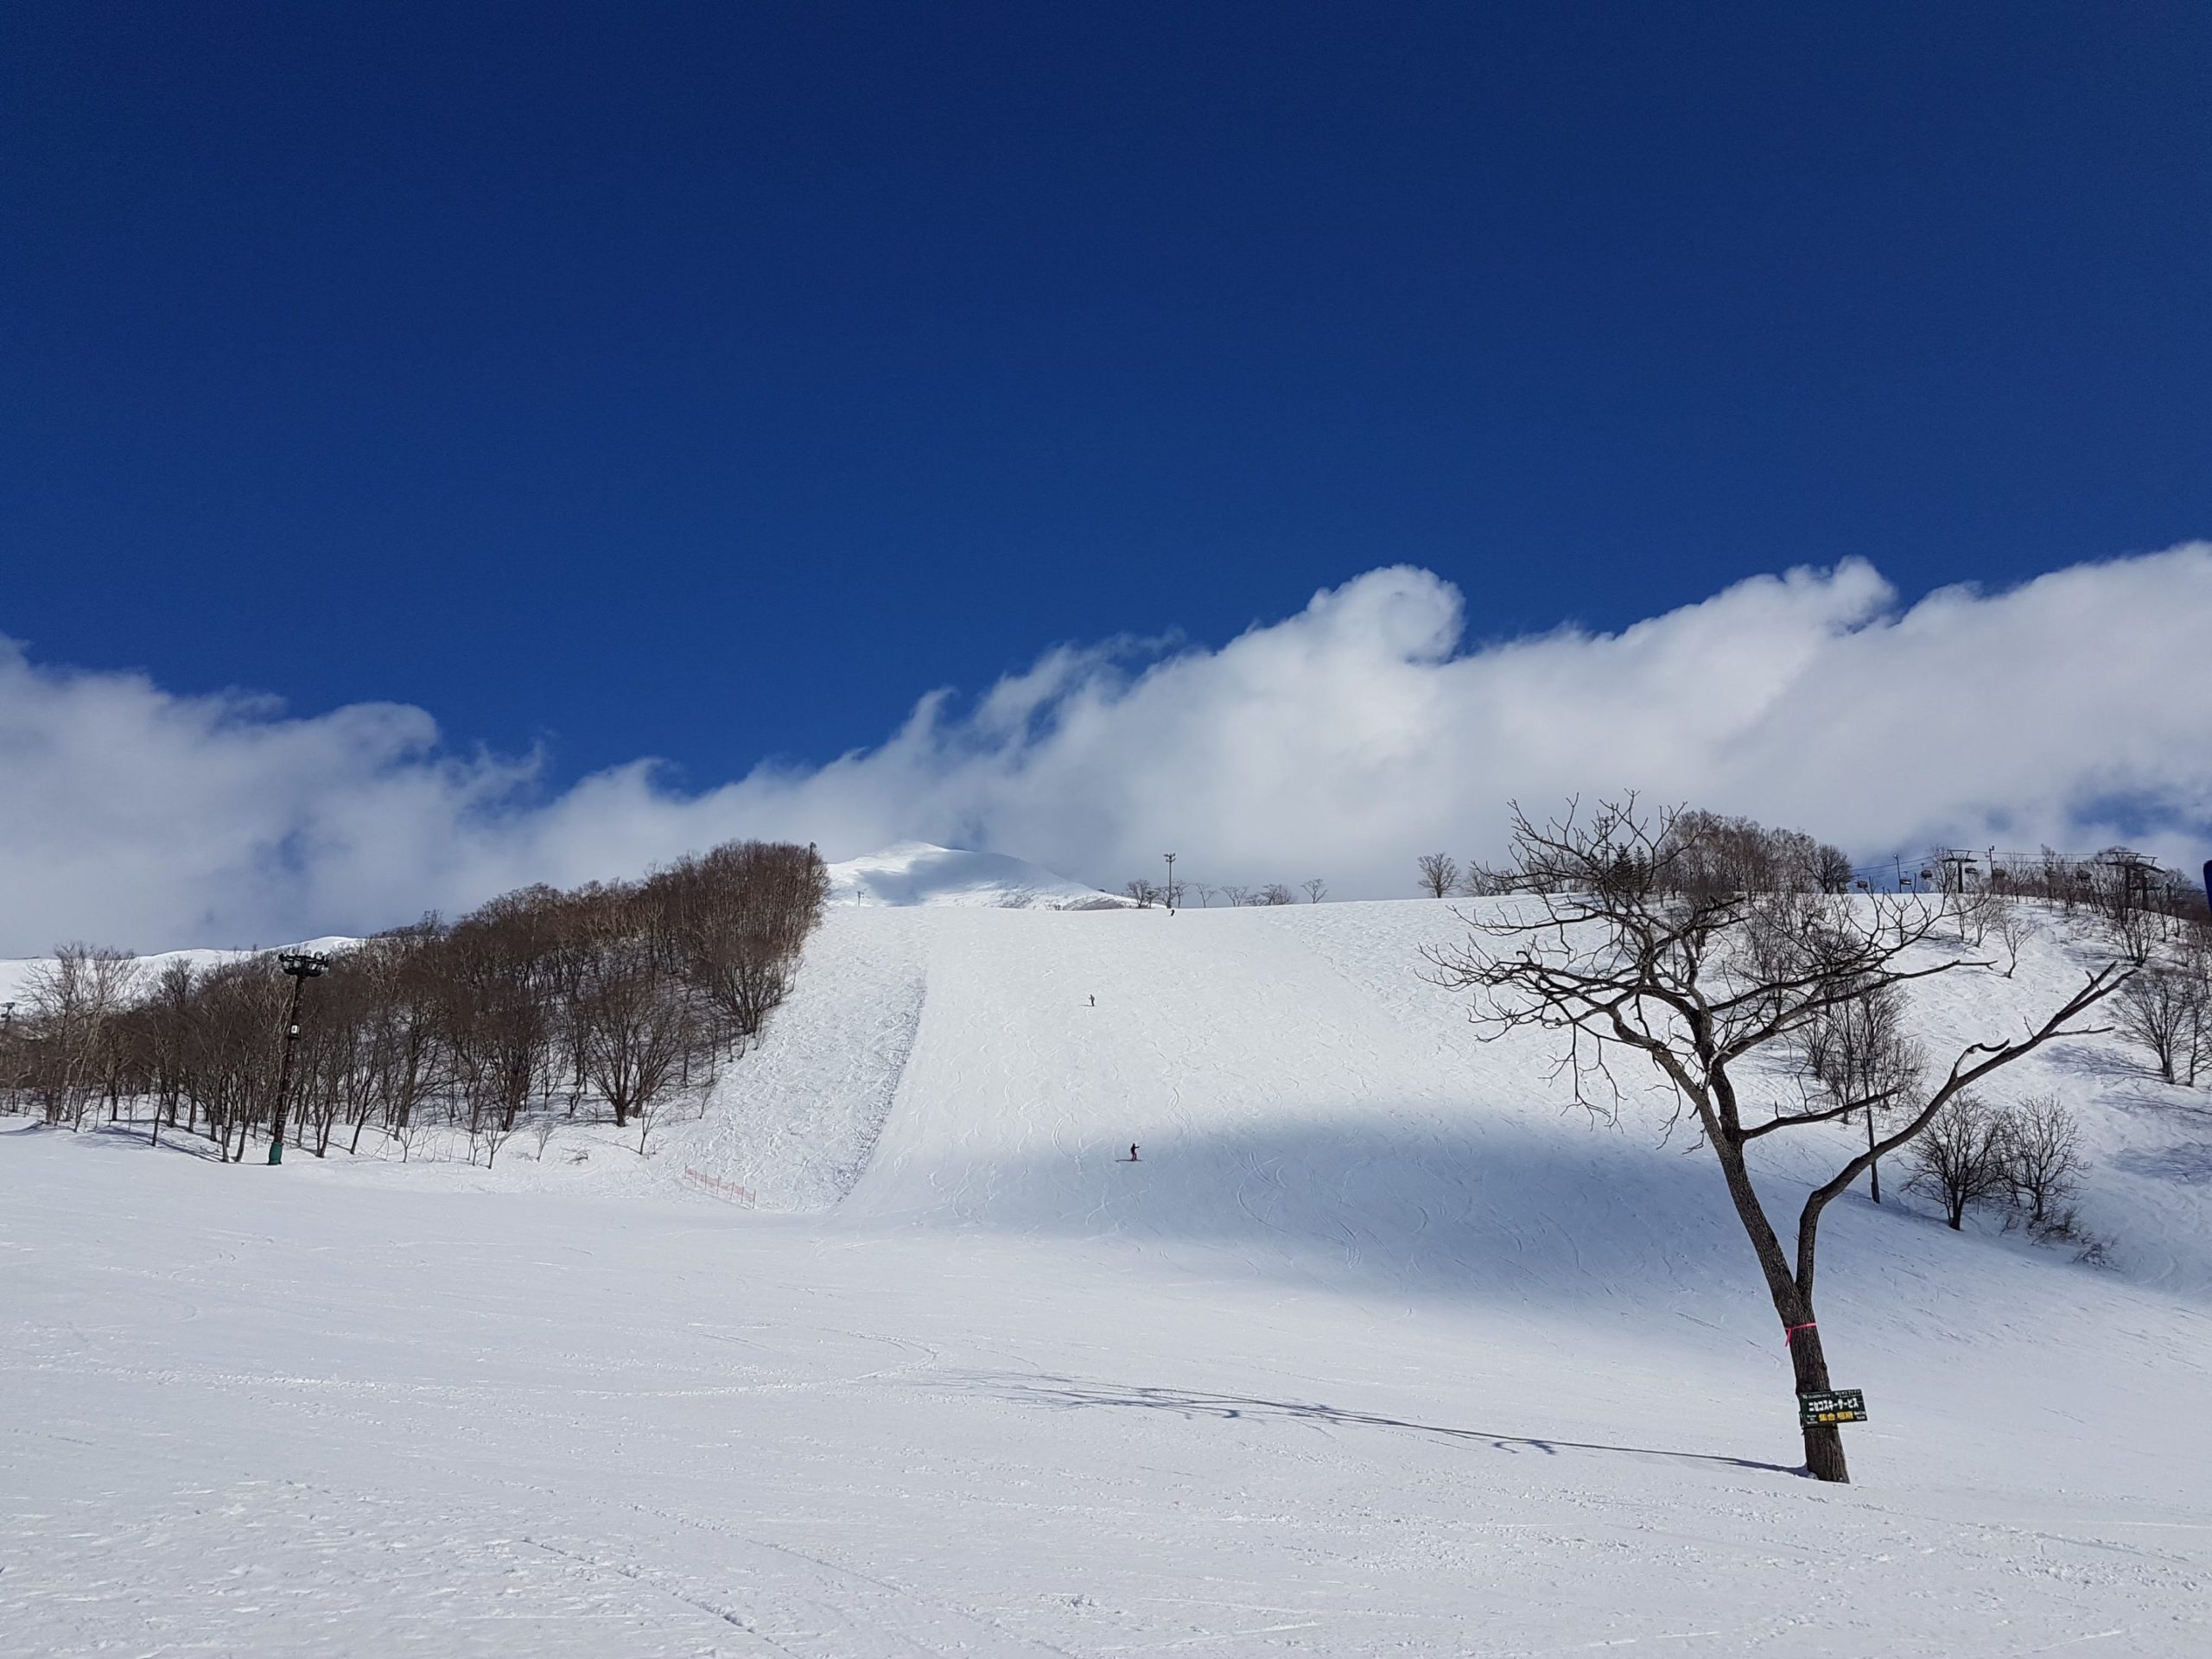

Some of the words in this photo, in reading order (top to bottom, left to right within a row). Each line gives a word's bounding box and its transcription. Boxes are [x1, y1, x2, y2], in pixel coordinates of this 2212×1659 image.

[1808, 1398, 1859, 1411] ニセコスキーサービス
